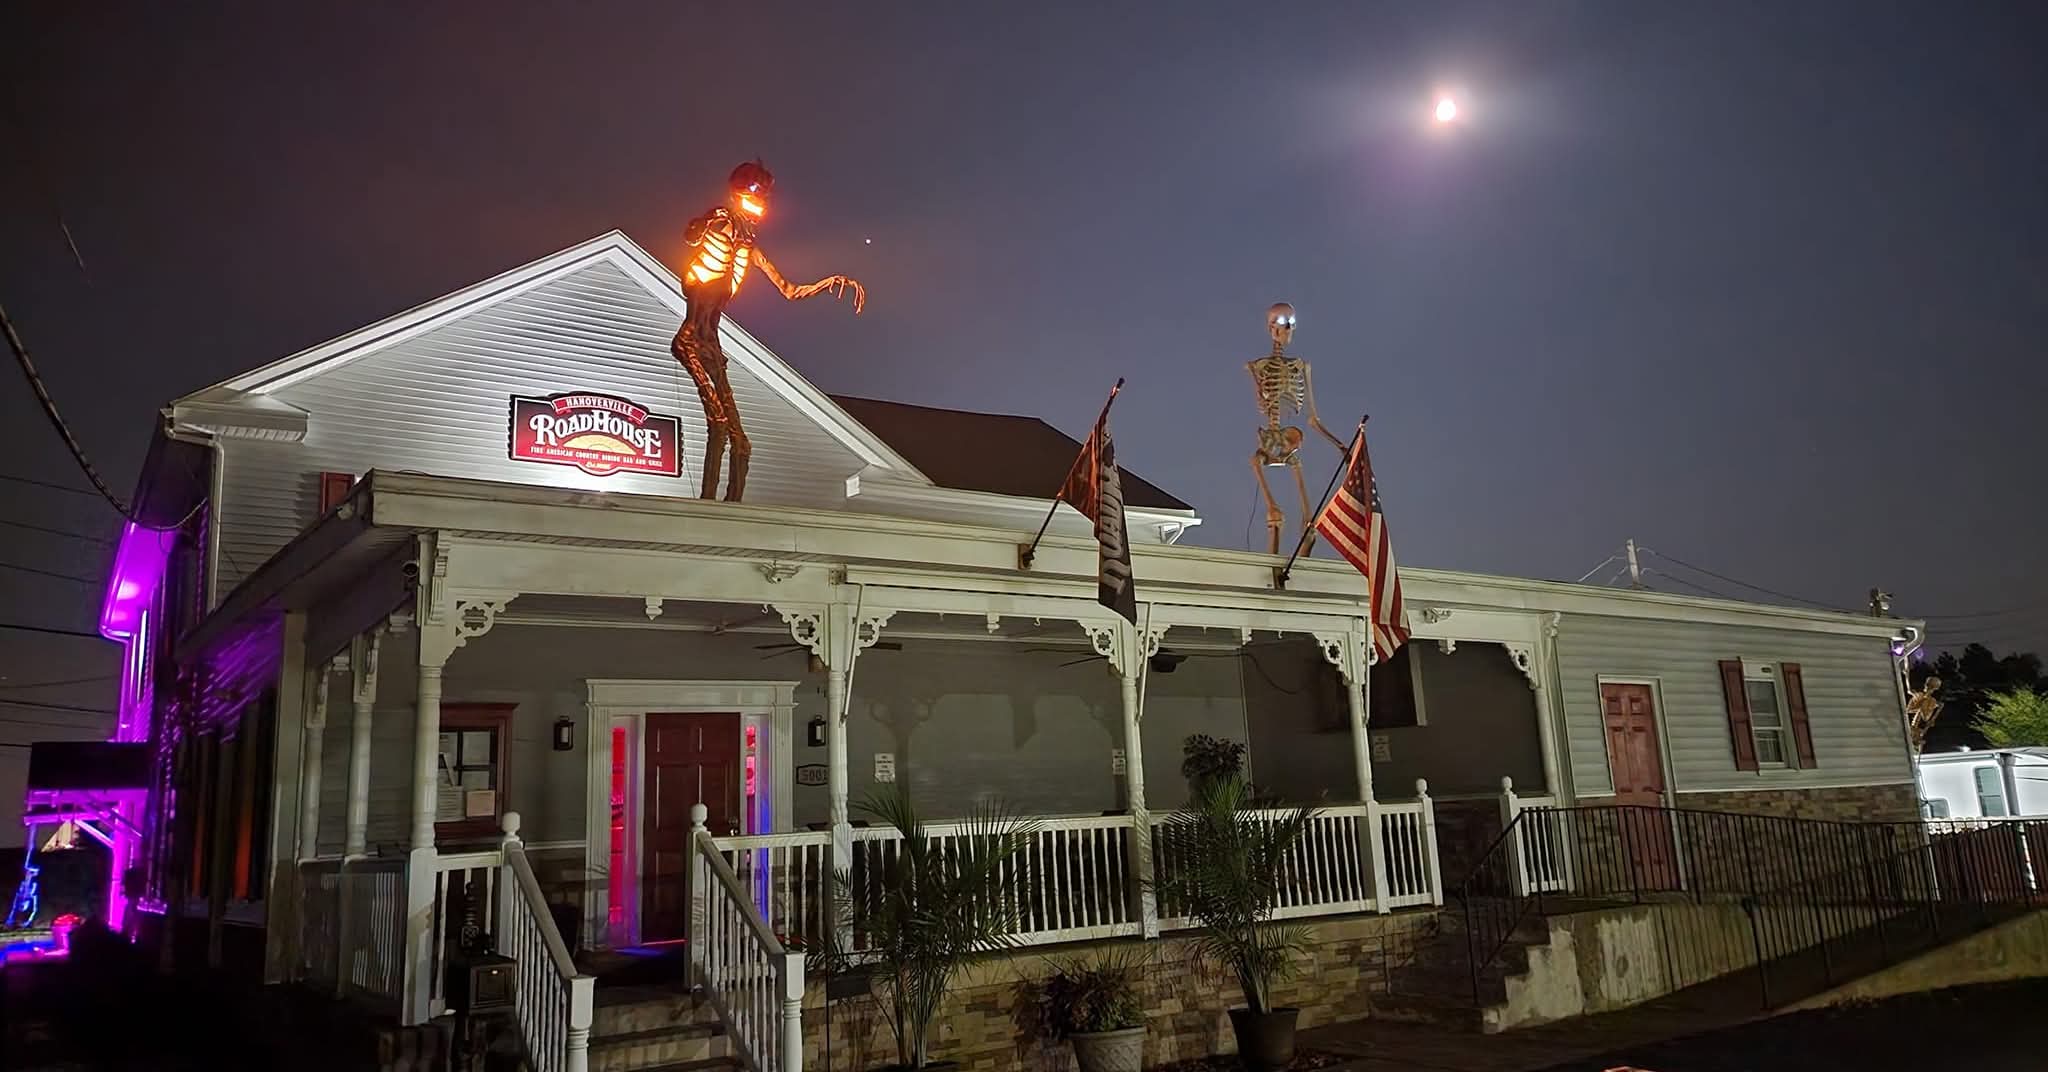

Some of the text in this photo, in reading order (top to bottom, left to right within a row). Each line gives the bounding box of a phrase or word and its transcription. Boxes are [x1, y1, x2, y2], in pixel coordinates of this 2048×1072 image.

[566, 397, 633, 415] HANOVERVILLE
[546, 448, 574, 457] AMERICAN
[576, 451, 599, 460] COUNTRY
